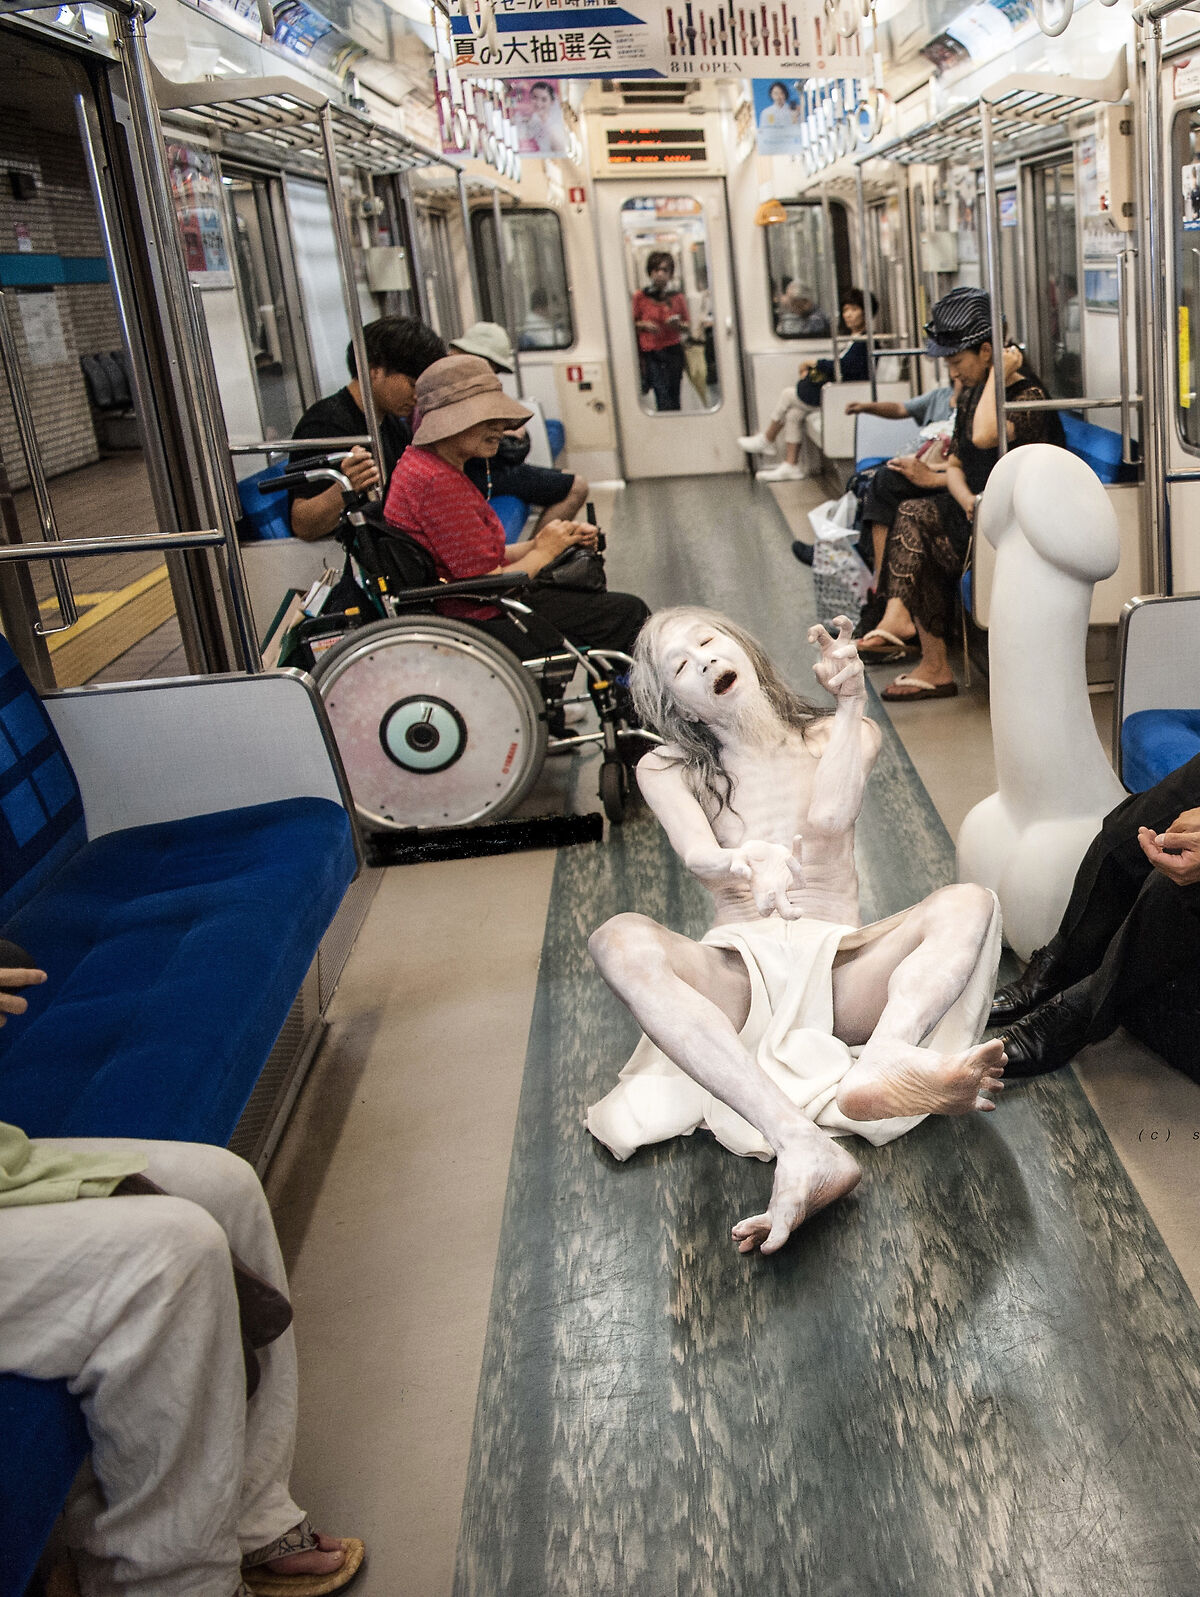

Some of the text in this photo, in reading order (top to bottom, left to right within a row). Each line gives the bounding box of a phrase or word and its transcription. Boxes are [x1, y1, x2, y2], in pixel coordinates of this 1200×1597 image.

[453, 32, 613, 67] 夏の大抽選会
[699, 61, 743, 73] OPEN
